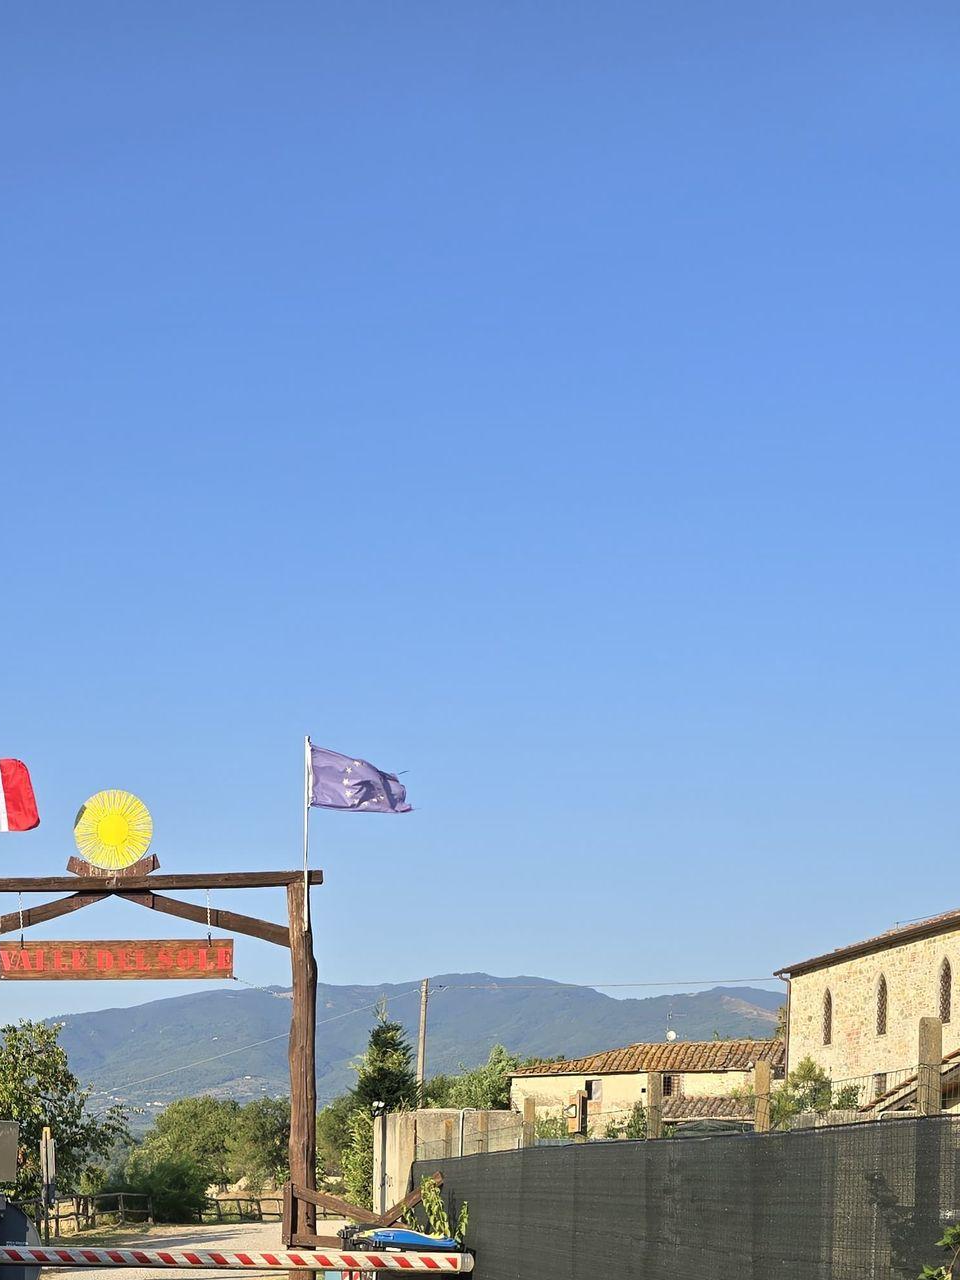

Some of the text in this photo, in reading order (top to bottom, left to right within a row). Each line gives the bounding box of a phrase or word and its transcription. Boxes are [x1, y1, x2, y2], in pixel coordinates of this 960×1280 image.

[0, 947, 232, 971] VALLE DEL SOLE
